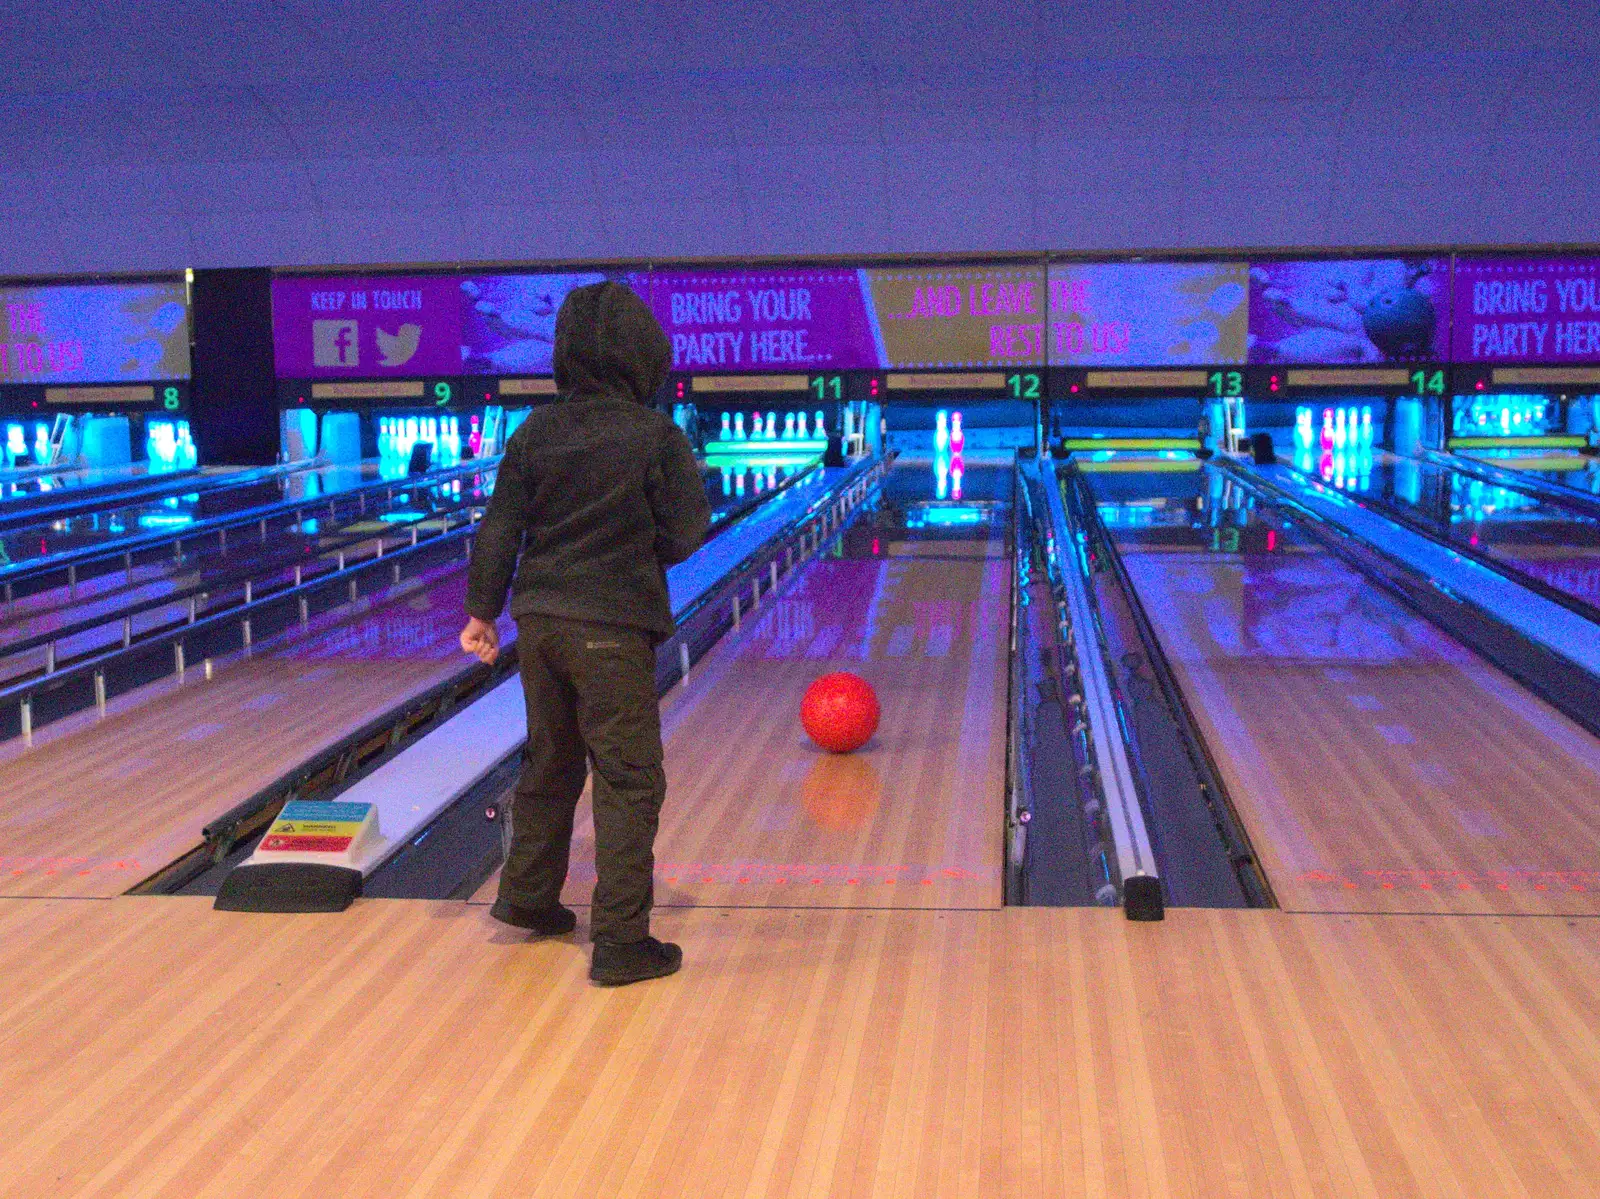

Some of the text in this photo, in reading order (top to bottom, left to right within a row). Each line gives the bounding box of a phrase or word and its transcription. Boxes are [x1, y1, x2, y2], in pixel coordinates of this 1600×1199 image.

[311, 289, 422, 311] KEEP IN TOUCH
[671, 287, 812, 325] BRING YOUR
[969, 281, 1037, 317] LEAVE
[1048, 279, 1092, 313] THE
[1473, 277, 1600, 316] BRING YOU
[6, 301, 47, 334] THE
[672, 328, 833, 367] PARTY HERE...
[990, 322, 1045, 358] REST
[1053, 321, 1084, 354] TO
[1473, 320, 1600, 357] PARTY HER
[15, 342, 42, 374] TO
[164, 387, 180, 410] 8
[434, 382, 451, 406] 9
[811, 376, 842, 399] 11
[1008, 374, 1041, 398] 12
[1209, 371, 1243, 396] 13
[1411, 370, 1445, 395] 14
